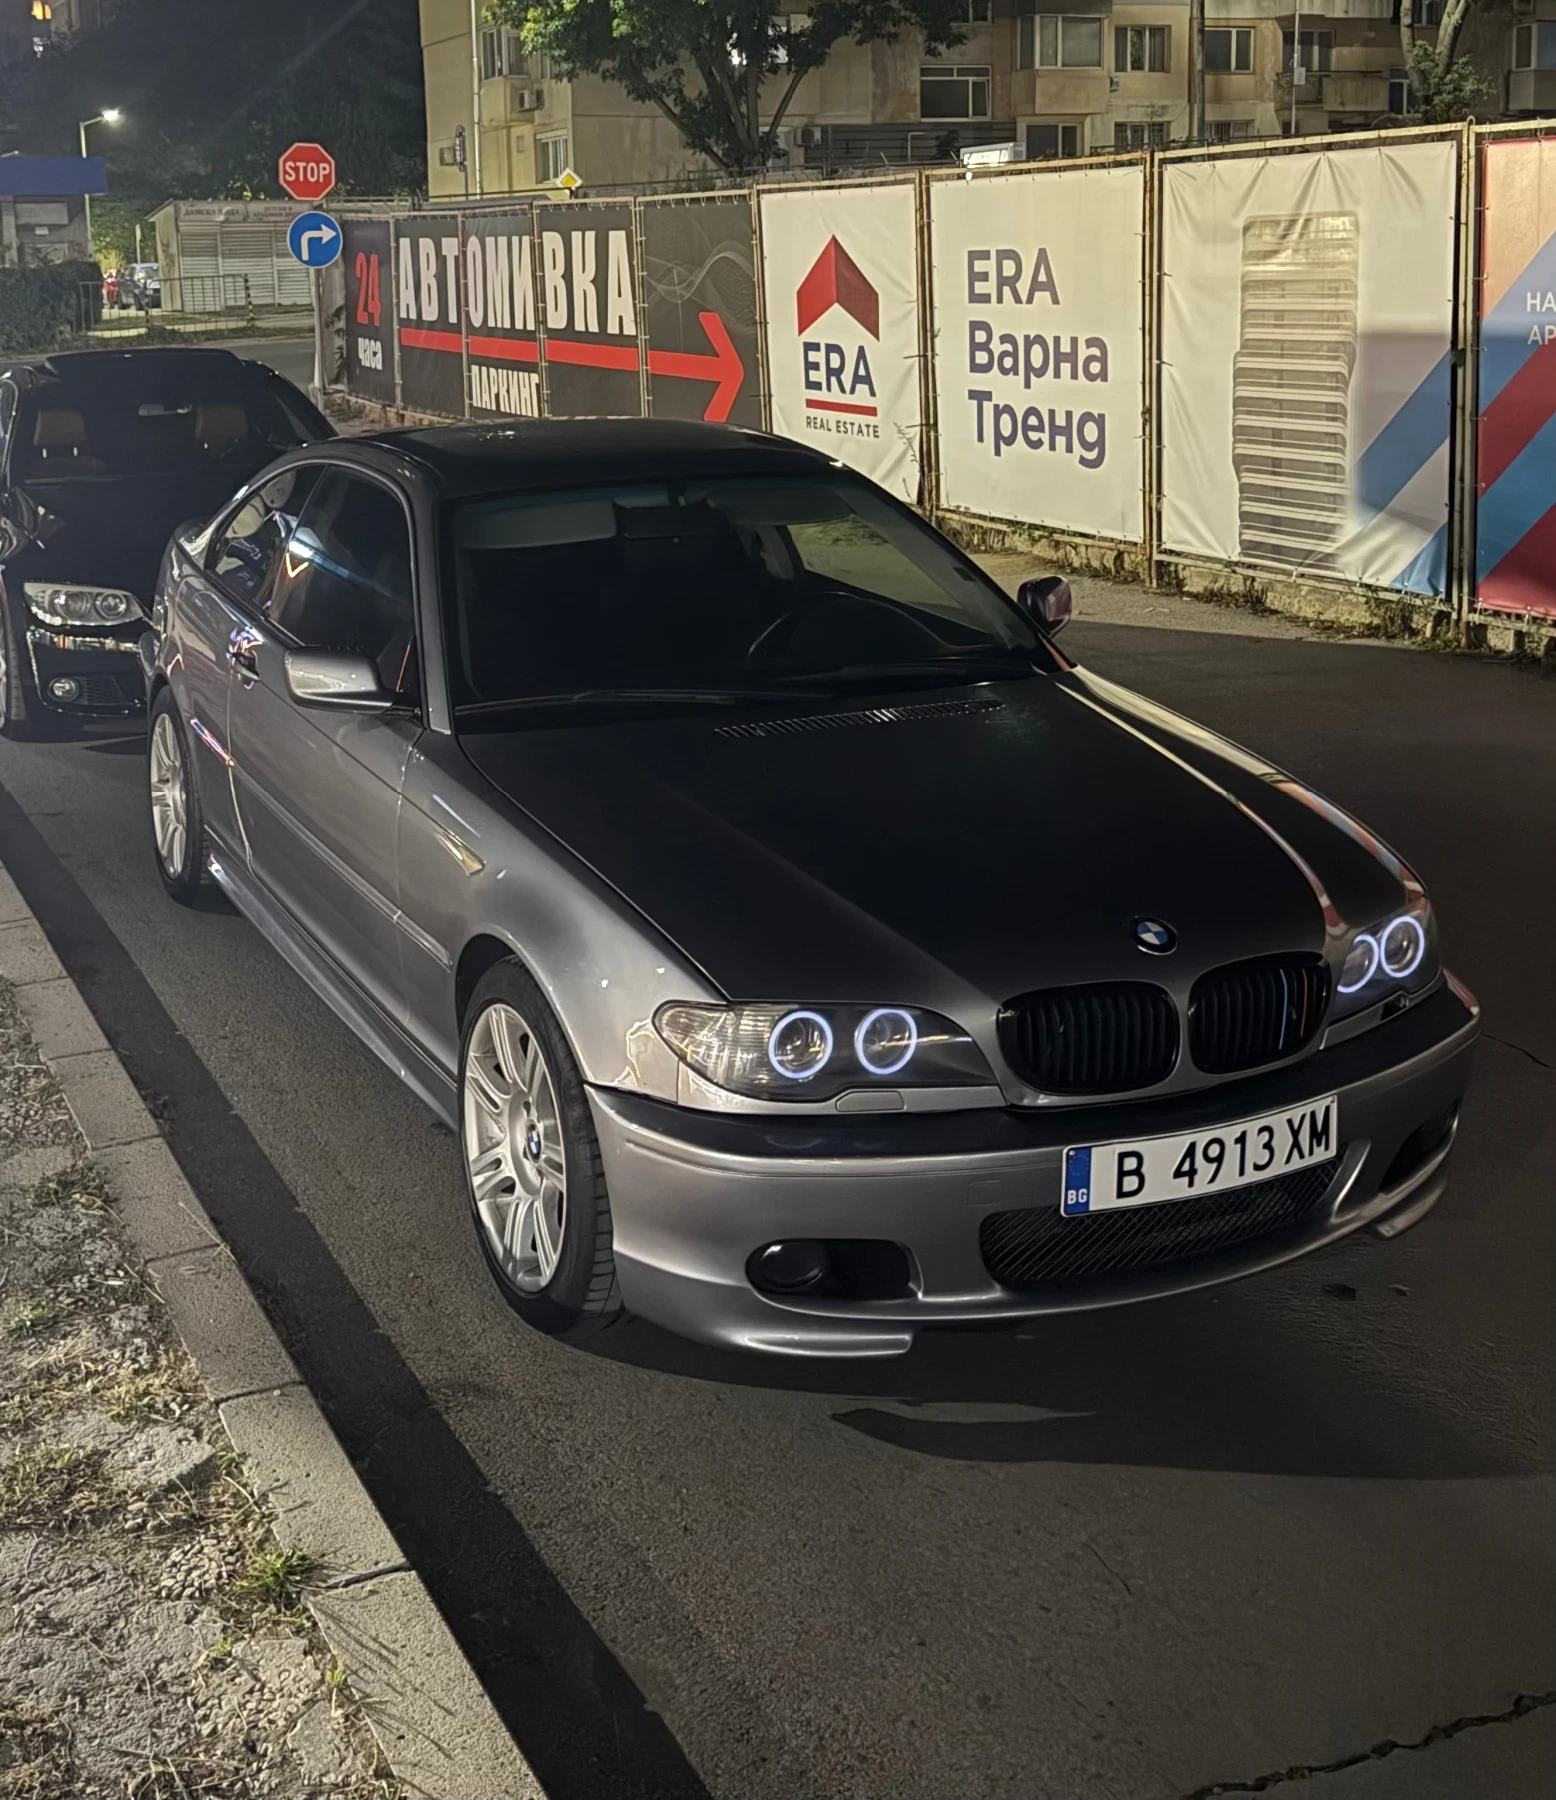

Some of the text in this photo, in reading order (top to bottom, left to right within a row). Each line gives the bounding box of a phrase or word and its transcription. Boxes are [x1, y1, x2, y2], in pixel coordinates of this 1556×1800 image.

[285, 161, 330, 182] STOP
[356, 251, 382, 327] 24
[398, 230, 637, 336] АВТОМИВКА
[967, 247, 1061, 305] ERA
[357, 336, 383, 371] часа
[802, 341, 877, 398] ERA
[968, 320, 1108, 390] Варна
[471, 364, 540, 418] ПАРКИНГ
[806, 415, 880, 438] REAL ESTATE
[967, 389, 1106, 469] Тренд
[1115, 1104, 1331, 1199] B 4913 XM
[1067, 1189, 1088, 1205] BG
